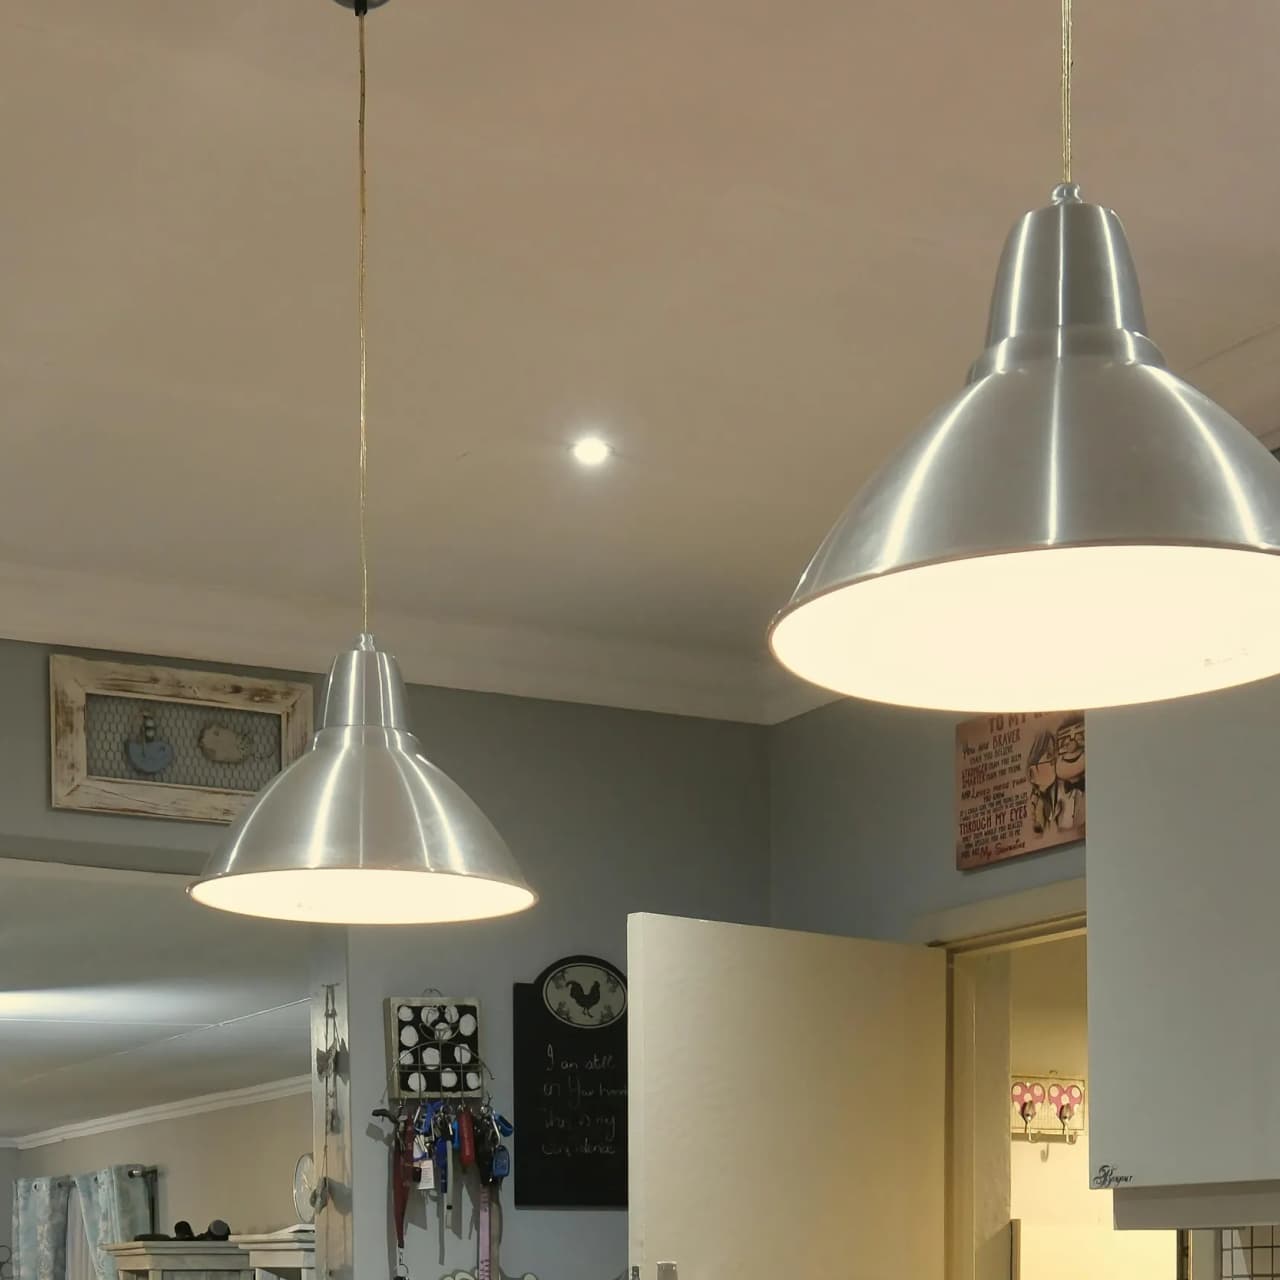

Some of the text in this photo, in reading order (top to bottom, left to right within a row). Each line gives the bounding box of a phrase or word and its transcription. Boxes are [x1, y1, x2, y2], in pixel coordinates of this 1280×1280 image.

[993, 728, 1020, 749] BRAVER
[960, 815, 992, 836] THROUGH
[996, 811, 1006, 826] MY
[1010, 805, 1028, 821] EYES
